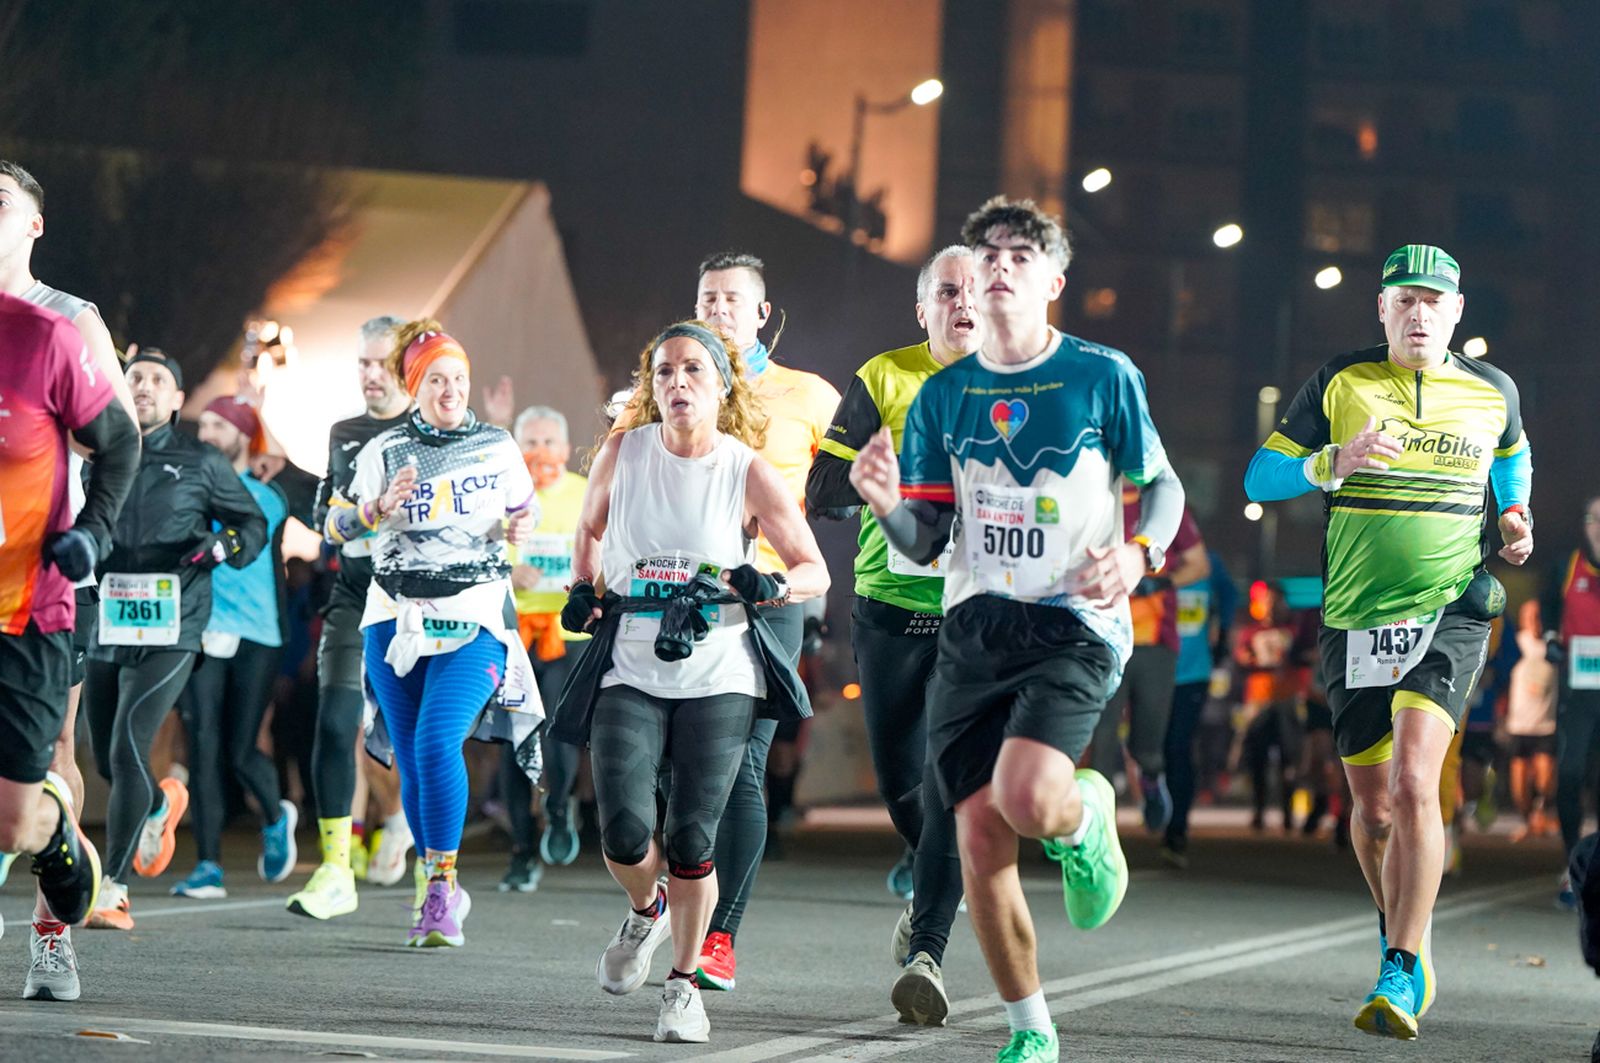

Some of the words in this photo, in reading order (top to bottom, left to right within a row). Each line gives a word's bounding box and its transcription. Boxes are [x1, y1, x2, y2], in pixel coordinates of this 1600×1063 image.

[984, 524, 1045, 559] 5700
[649, 559, 677, 569] NOCHE
[638, 569, 657, 579] SAN
[117, 600, 162, 620] 7361
[909, 619, 940, 627] RESS
[904, 627, 938, 635] PORT
